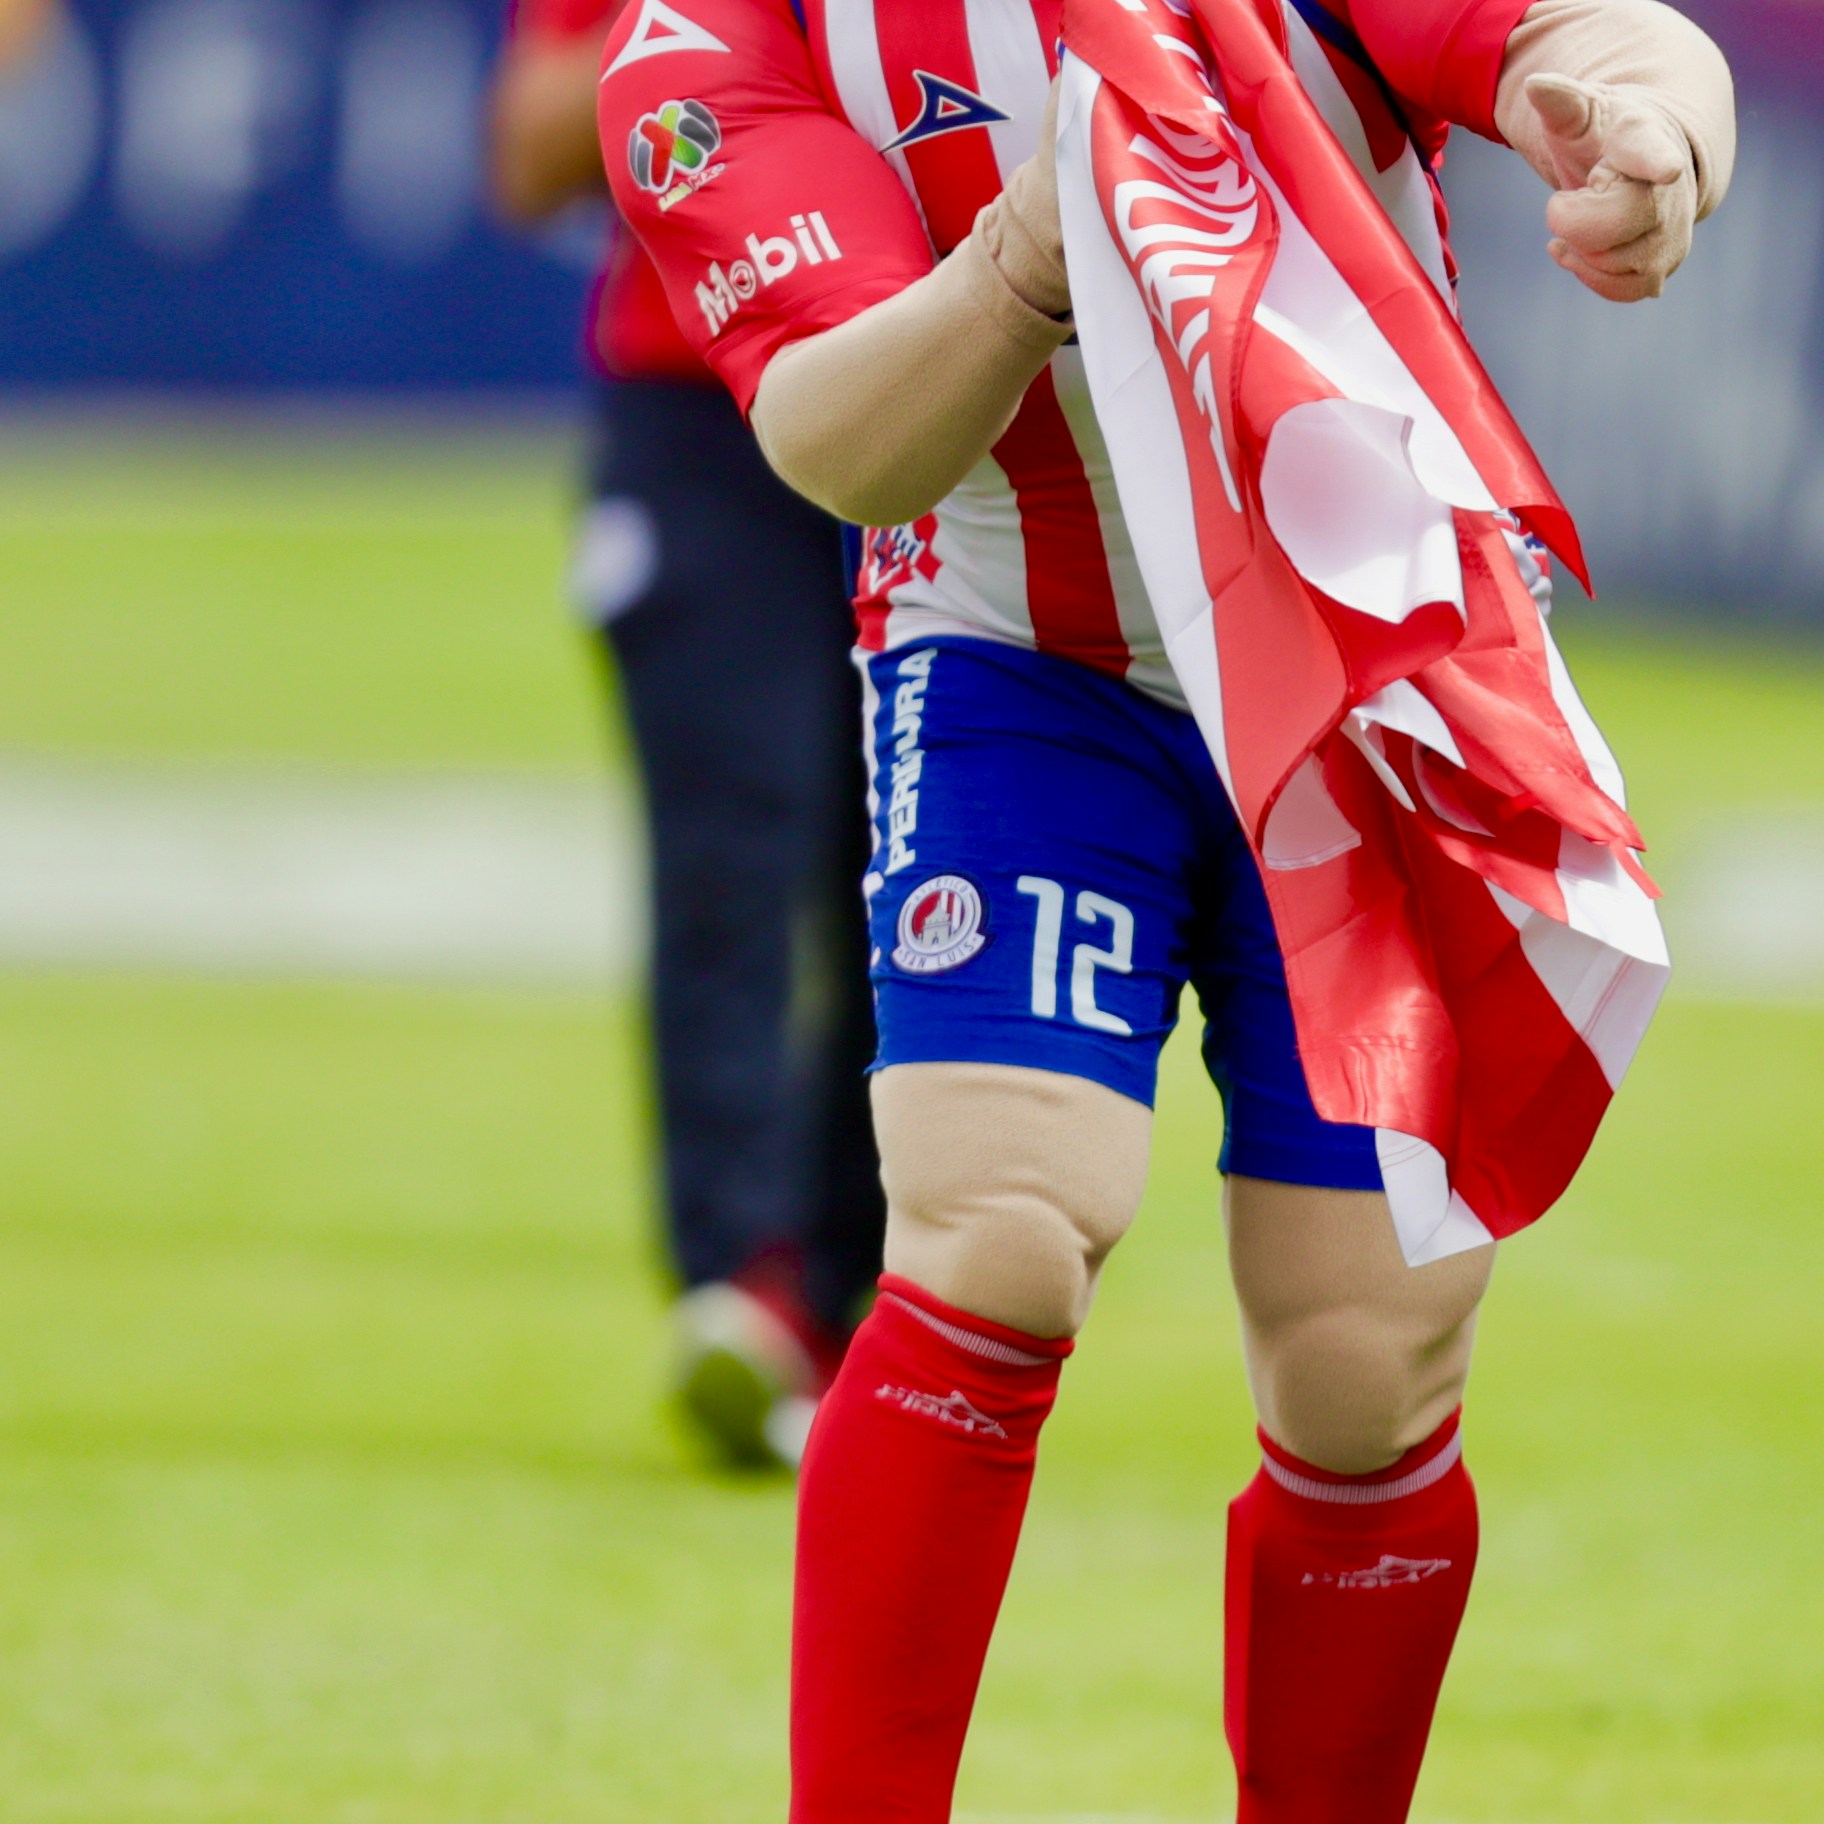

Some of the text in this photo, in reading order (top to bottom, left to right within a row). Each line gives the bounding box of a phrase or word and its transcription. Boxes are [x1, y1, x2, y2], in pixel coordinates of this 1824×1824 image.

[693, 209, 843, 338] Mobil
[936, 940, 975, 967] LUIS
[1016, 875, 1135, 1037] 12
